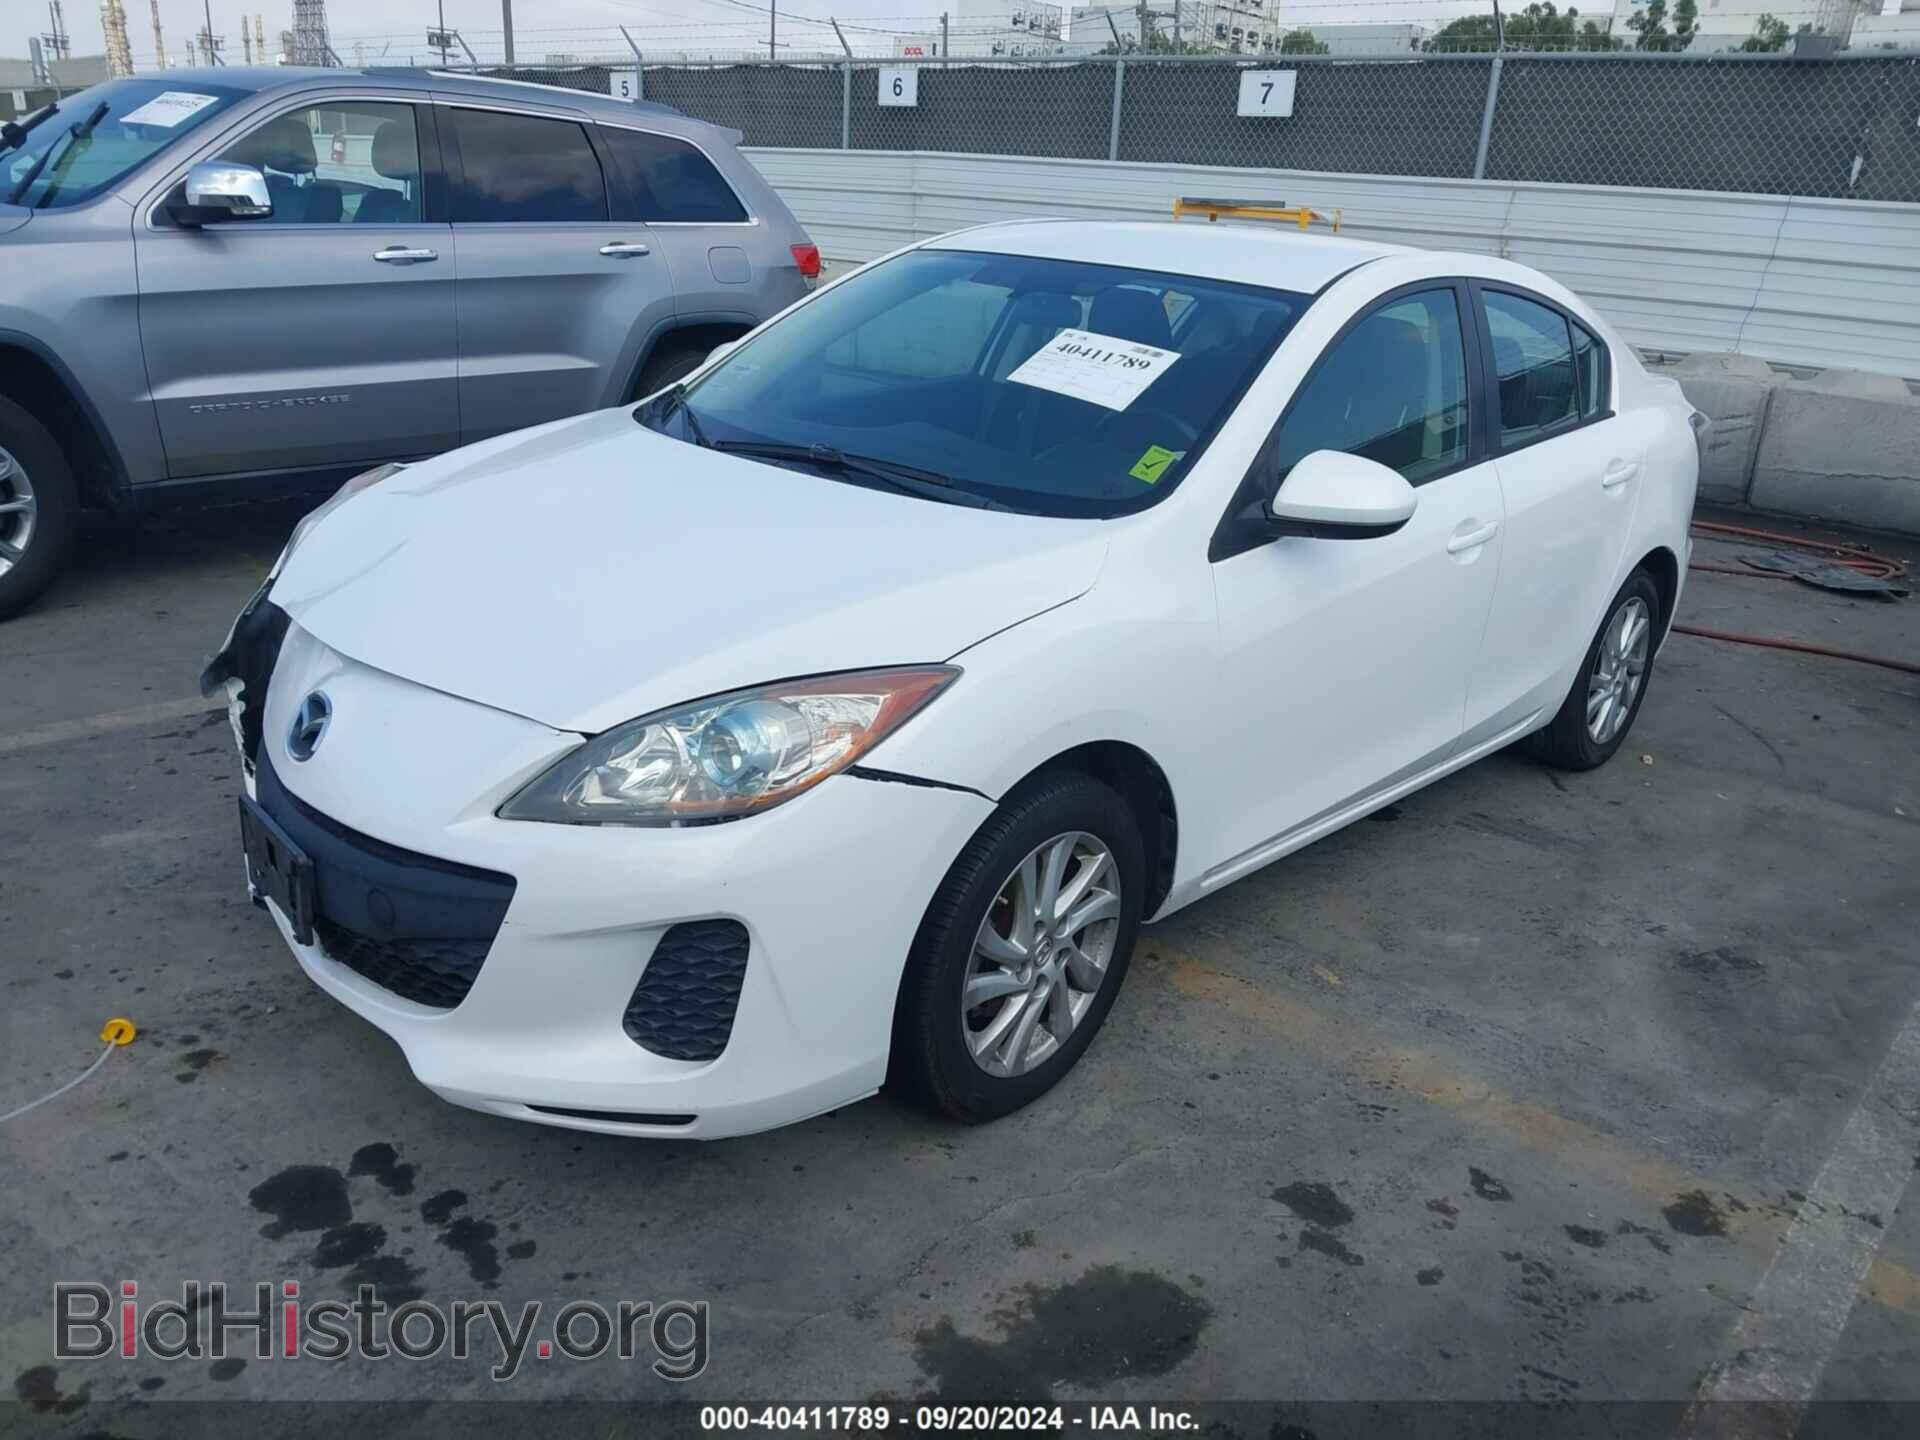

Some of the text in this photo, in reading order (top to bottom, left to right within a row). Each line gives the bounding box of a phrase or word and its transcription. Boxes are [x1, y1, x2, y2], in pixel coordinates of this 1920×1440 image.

[621, 80, 629, 97] 5
[893, 77, 903, 96] 6
[1261, 82, 1274, 104] 7
[1057, 342, 1151, 370] 40411789
